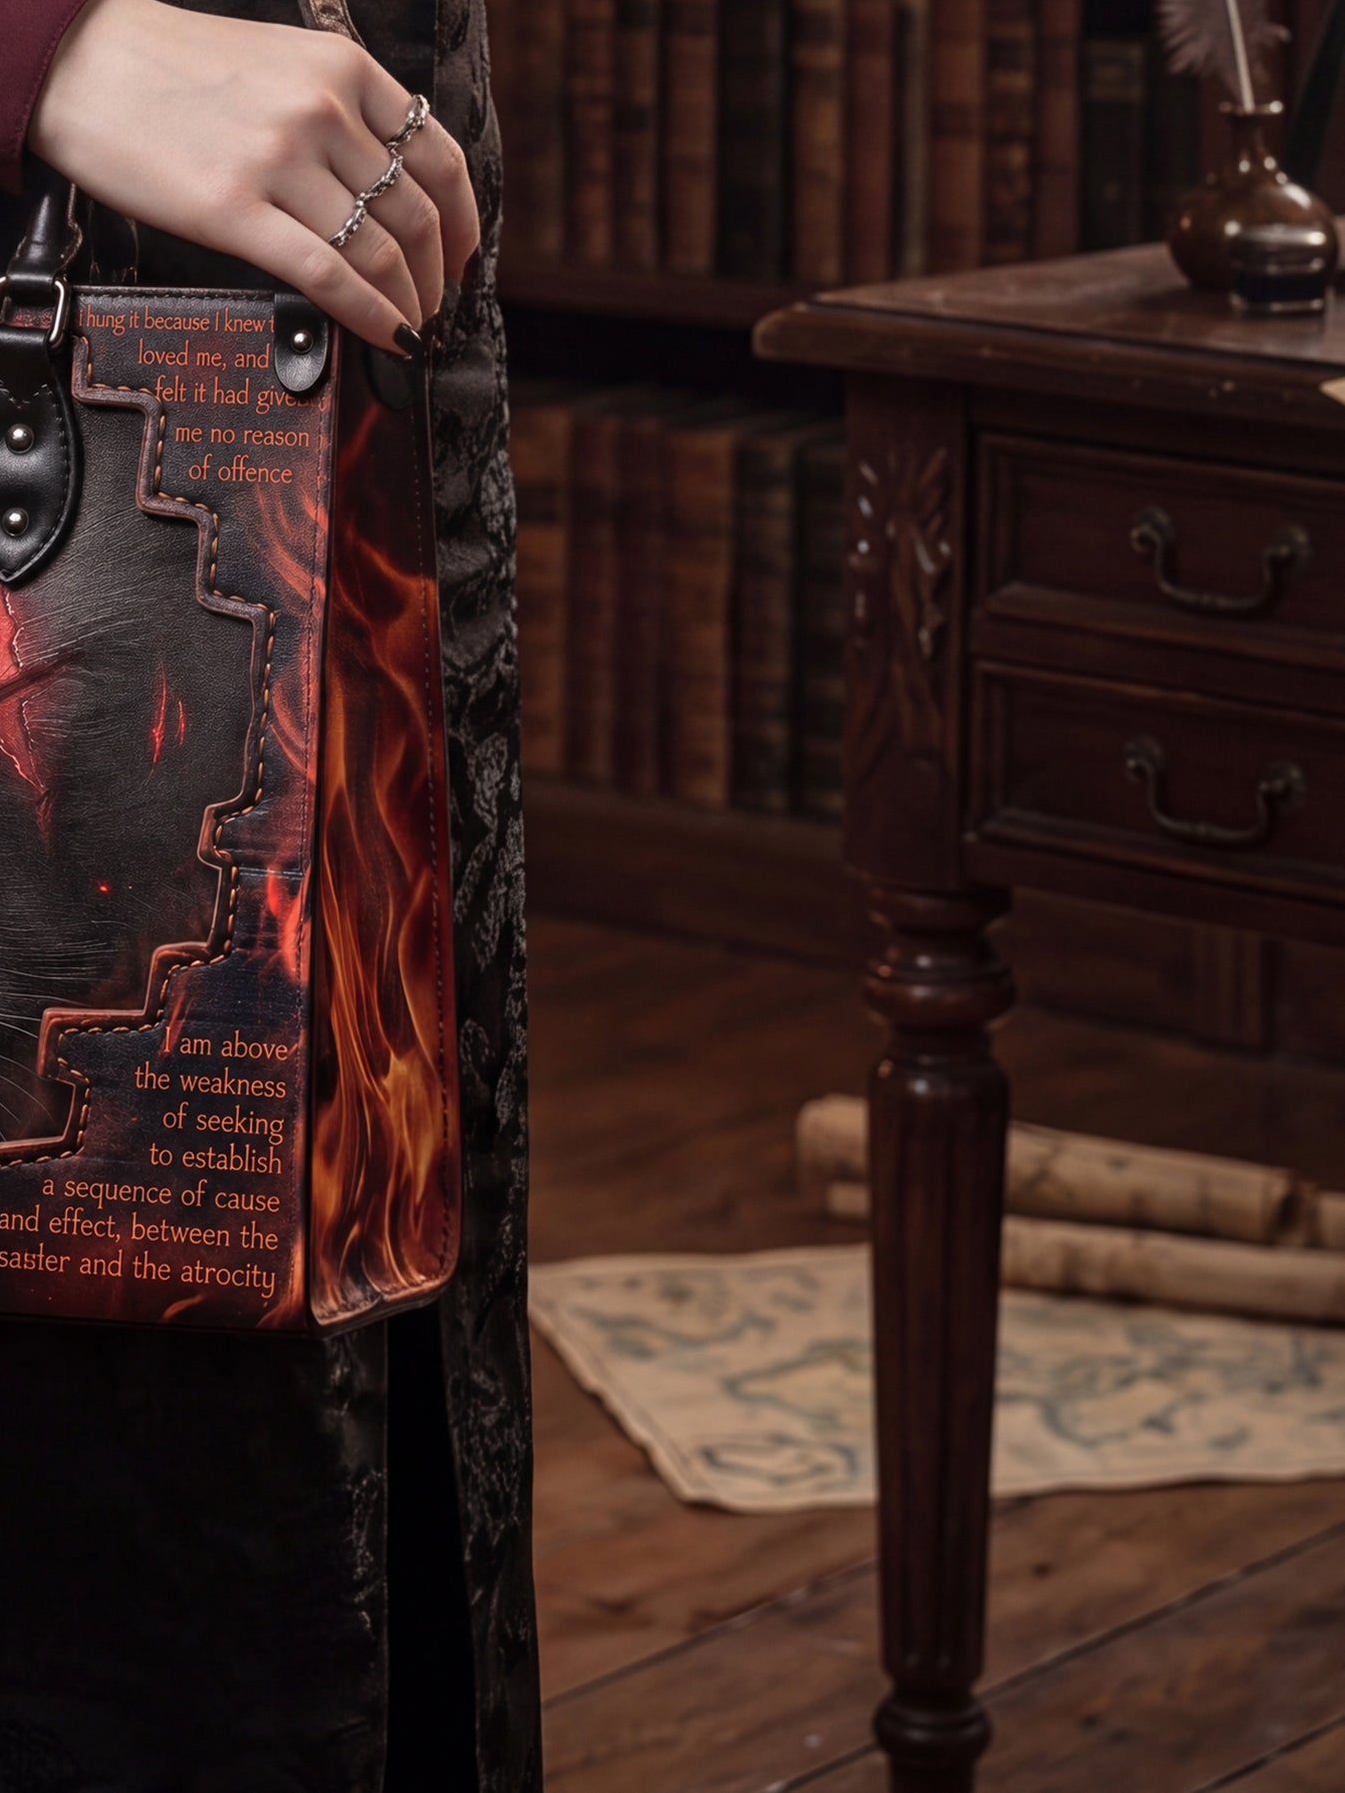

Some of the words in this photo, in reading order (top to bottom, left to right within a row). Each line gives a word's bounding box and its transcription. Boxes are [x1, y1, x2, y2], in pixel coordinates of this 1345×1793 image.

[86, 304, 126, 336] hung
[129, 310, 140, 328] it
[144, 305, 210, 331] because
[214, 311, 219, 332] I
[225, 307, 266, 332] knew
[138, 338, 189, 366] loved
[196, 351, 227, 371] me,
[234, 343, 271, 369] and
[155, 375, 187, 402] felt
[194, 383, 206, 403] it
[213, 377, 250, 405] had
[175, 427, 203, 443] me
[210, 428, 236, 444] no
[243, 429, 310, 447] reason
[188, 453, 212, 480] of
[218, 454, 293, 484] offence
[163, 1027, 171, 1052] I
[179, 1035, 211, 1056] am
[220, 1030, 288, 1061] above
[135, 1061, 170, 1090] the
[179, 1067, 286, 1098] weakness
[162, 1102, 189, 1129] of
[196, 1105, 284, 1145] seeking
[149, 1143, 173, 1166] to
[181, 1143, 282, 1174] establish
[42, 1178, 54, 1195] a
[64, 1179, 171, 1209] sequence
[180, 1180, 207, 1206] of
[214, 1191, 280, 1212] cause
[48, 1207, 121, 1242] effect,
[131, 1212, 230, 1247] between
[240, 1221, 278, 1250] the
[79, 1249, 123, 1277] and
[133, 1251, 171, 1280] the
[180, 1262, 276, 1298] atrocity
